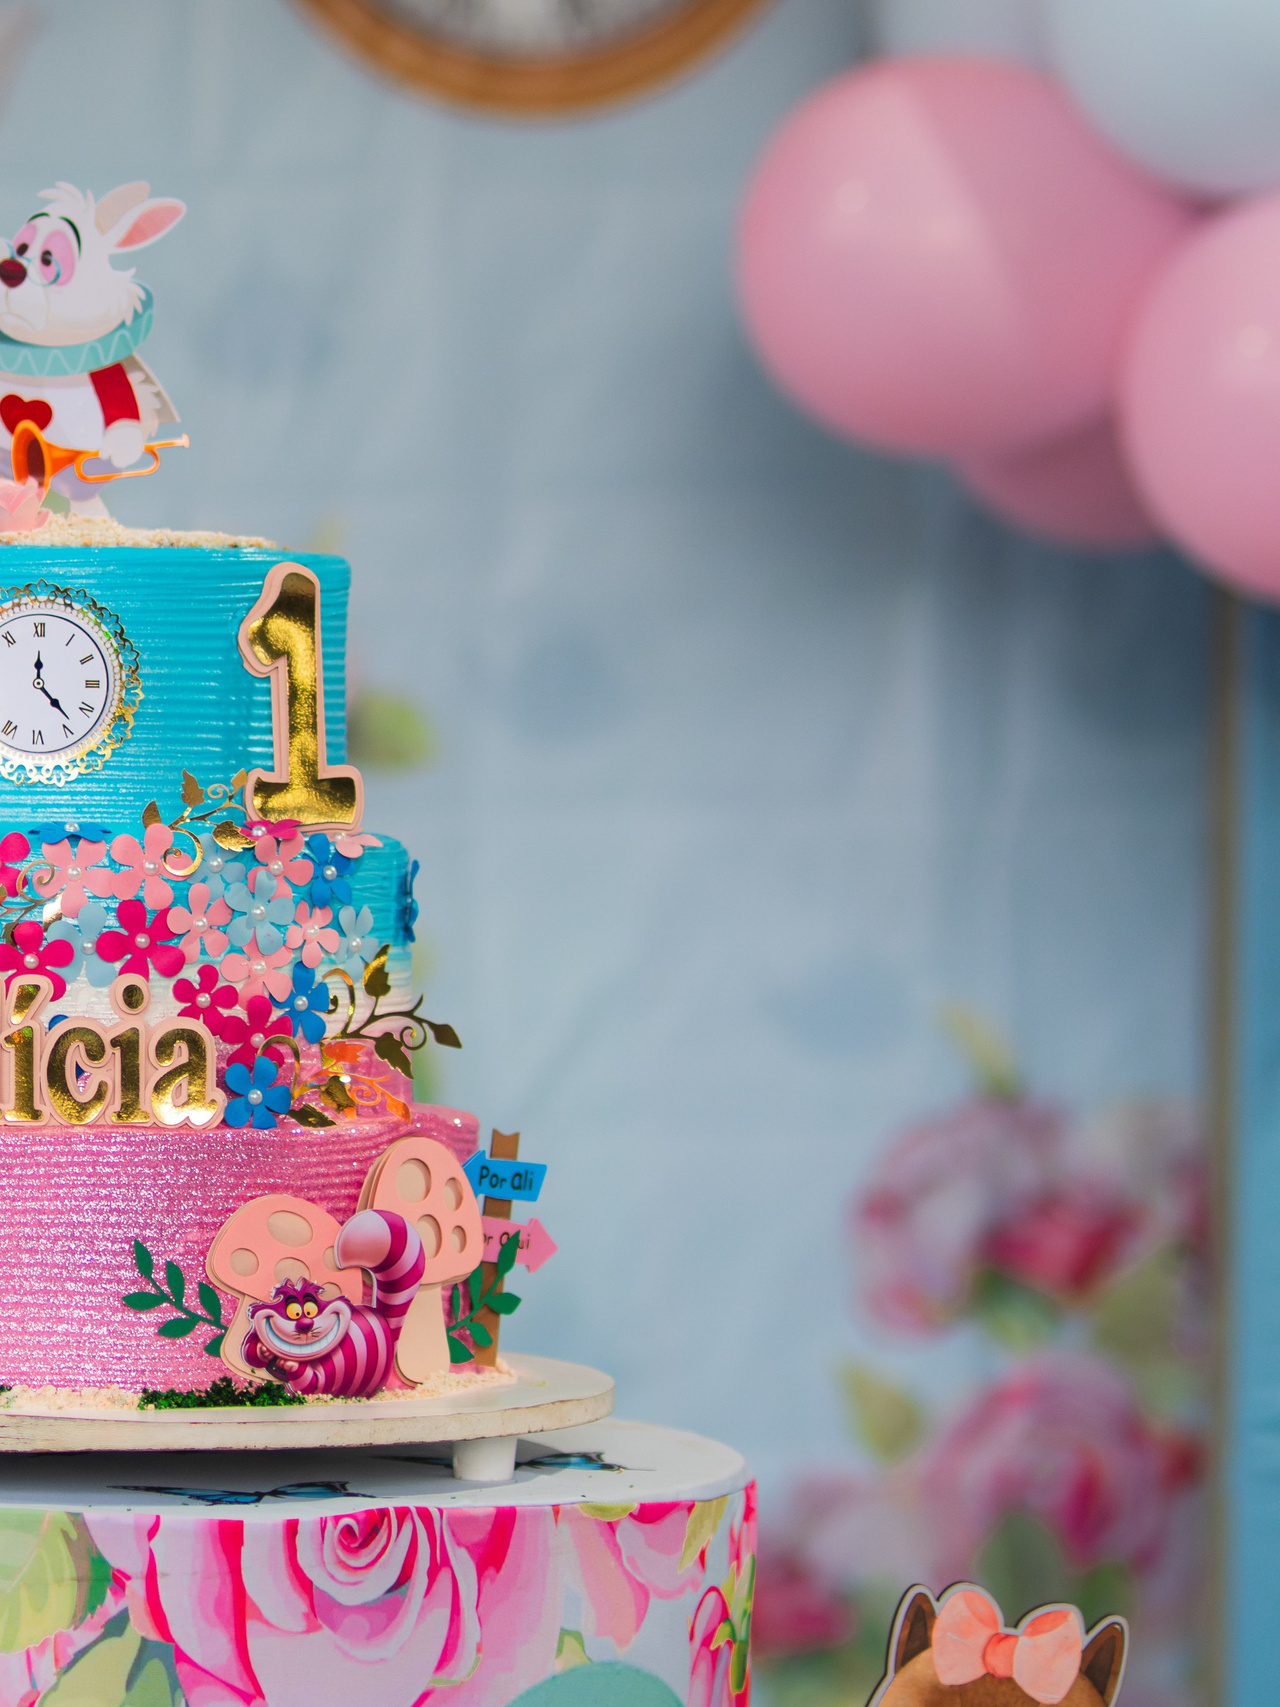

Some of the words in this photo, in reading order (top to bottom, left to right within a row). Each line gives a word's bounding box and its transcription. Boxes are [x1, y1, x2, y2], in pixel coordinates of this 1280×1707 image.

[1, 630, 16, 647] XI
[33, 622, 46, 638] XII
[248, 572, 356, 825] 1
[79, 701, 95, 718] IV
[1, 720, 18, 740] VII
[32, 730, 44, 745] VI
[62, 724, 74, 738] V
[478, 1165, 507, 1189] Por
